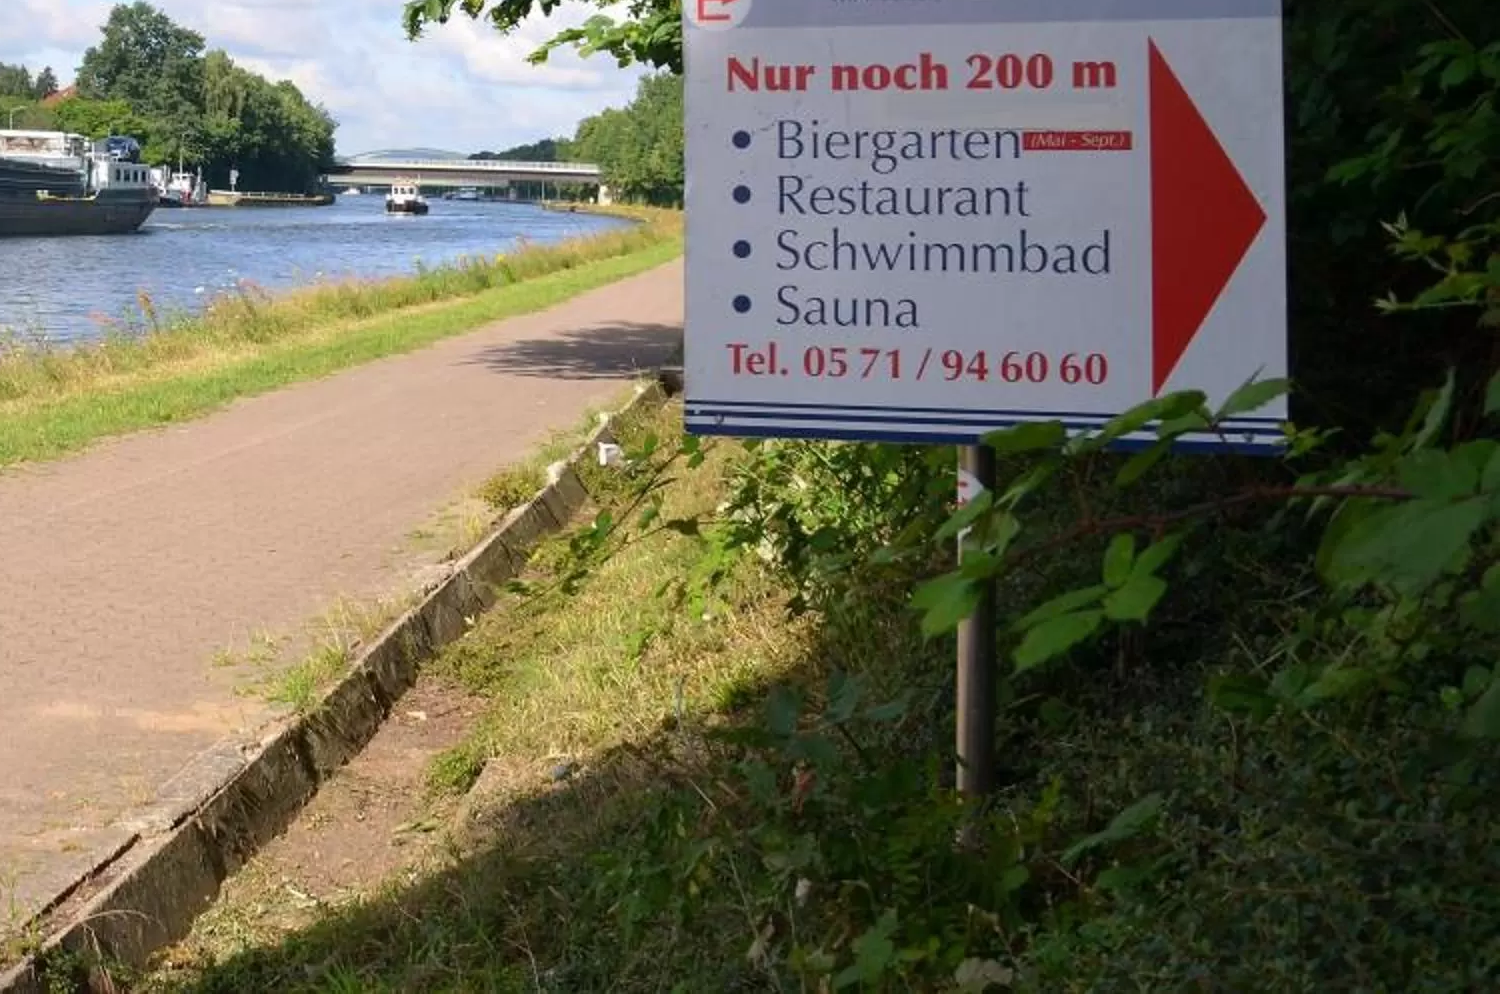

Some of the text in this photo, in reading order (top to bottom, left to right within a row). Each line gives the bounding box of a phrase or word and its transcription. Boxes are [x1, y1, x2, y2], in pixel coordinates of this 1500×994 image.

[727, 53, 1117, 92] Nur noch 200 m
[777, 119, 1021, 174] Biergarten
[777, 174, 1030, 218] Restaurant
[776, 227, 1111, 275] Schwimmbad
[776, 285, 920, 328] Sauna
[726, 342, 788, 376] Tel.
[803, 346, 848, 377] 05
[860, 347, 901, 379] 71
